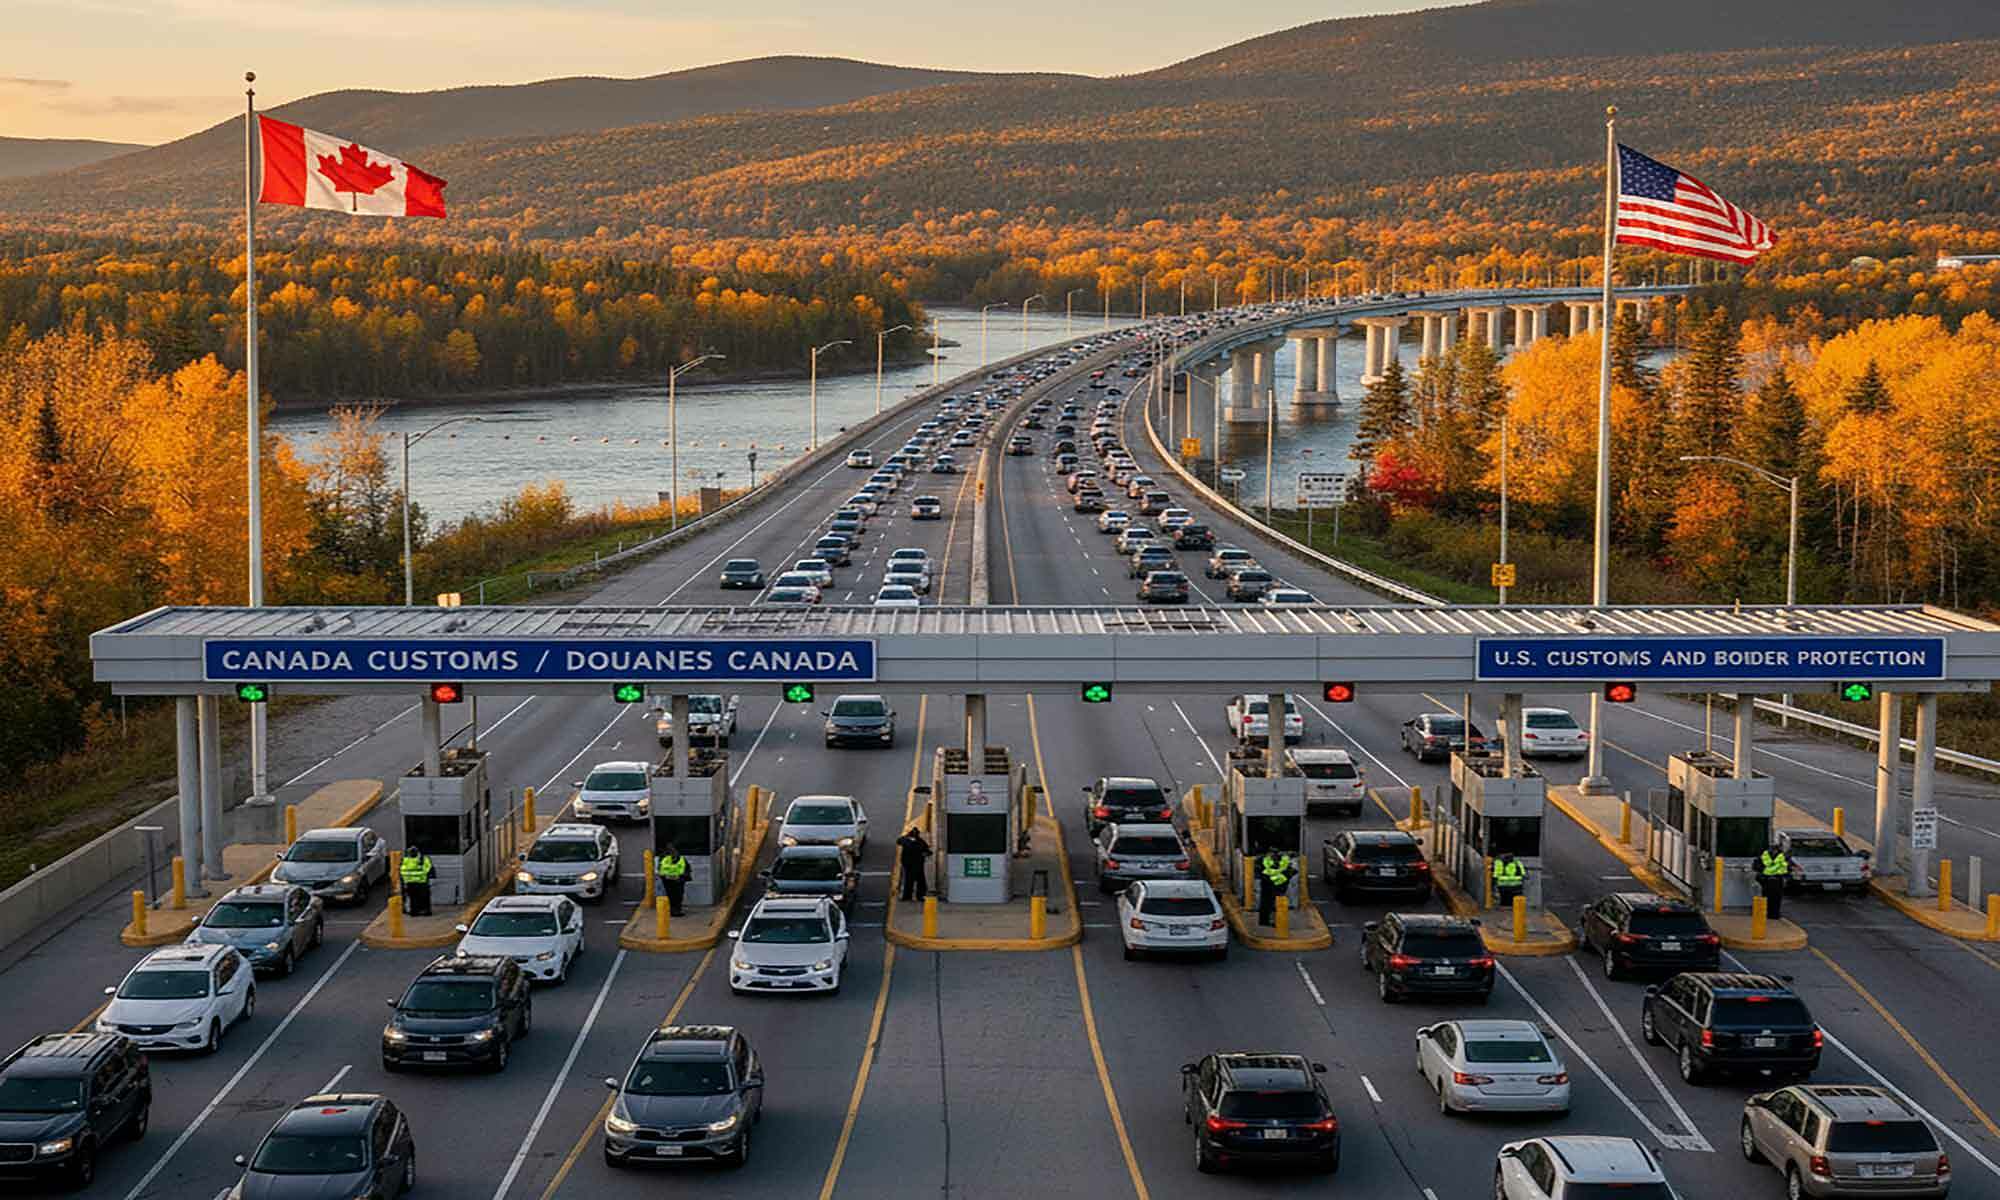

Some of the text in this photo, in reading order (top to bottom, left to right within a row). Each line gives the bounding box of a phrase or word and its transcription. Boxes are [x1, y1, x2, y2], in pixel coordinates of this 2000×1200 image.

[222, 650, 859, 673] CANADA CUSTOMS / DOUANES CANADA
[1495, 650, 1537, 666] U.S.
[1547, 650, 1652, 666] CUSTOMS
[1661, 650, 1706, 666] AND
[1797, 650, 1926, 666] PROTECTION
